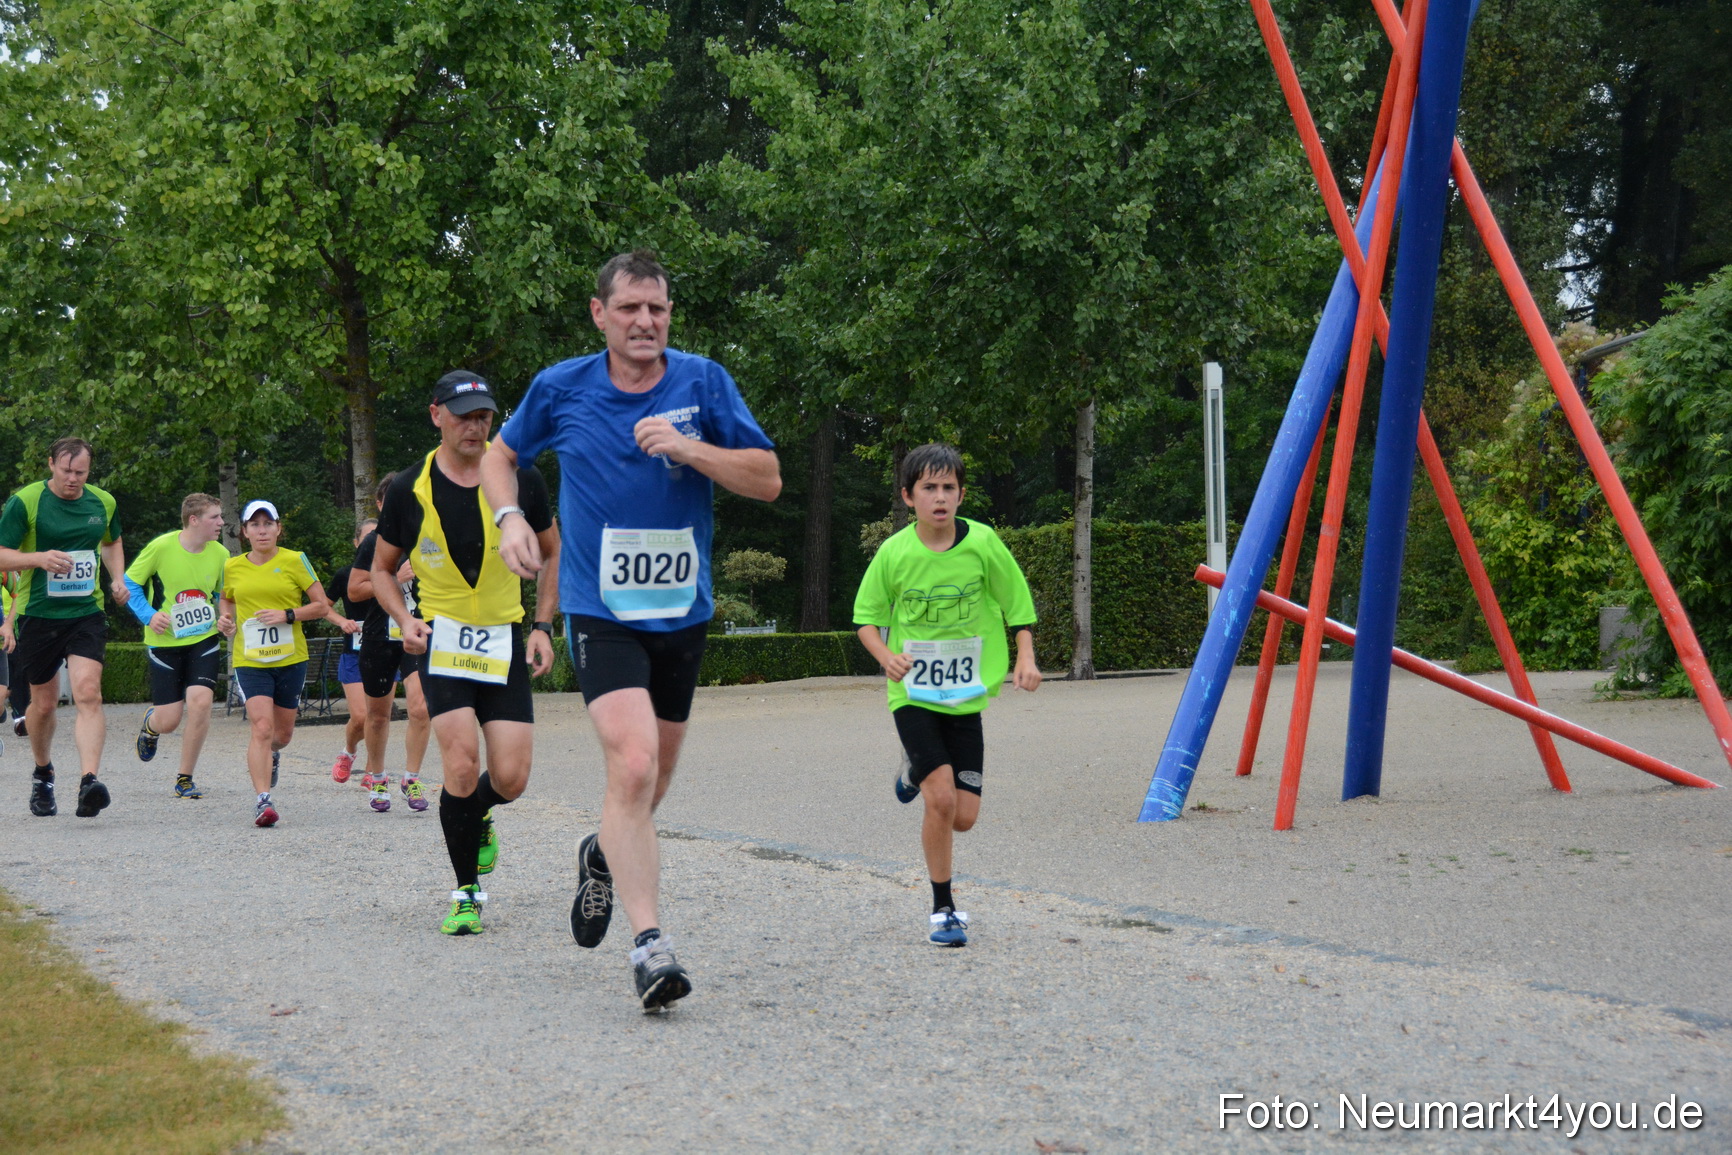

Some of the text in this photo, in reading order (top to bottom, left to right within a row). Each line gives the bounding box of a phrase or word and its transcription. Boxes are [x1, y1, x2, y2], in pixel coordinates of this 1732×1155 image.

[53, 561, 93, 579] 53
[612, 552, 691, 585] 3020
[175, 606, 211, 628] 3099
[258, 627, 279, 645] 70
[459, 626, 490, 653] 62
[453, 656, 488, 673] Ludwig
[913, 657, 973, 687] 2643
